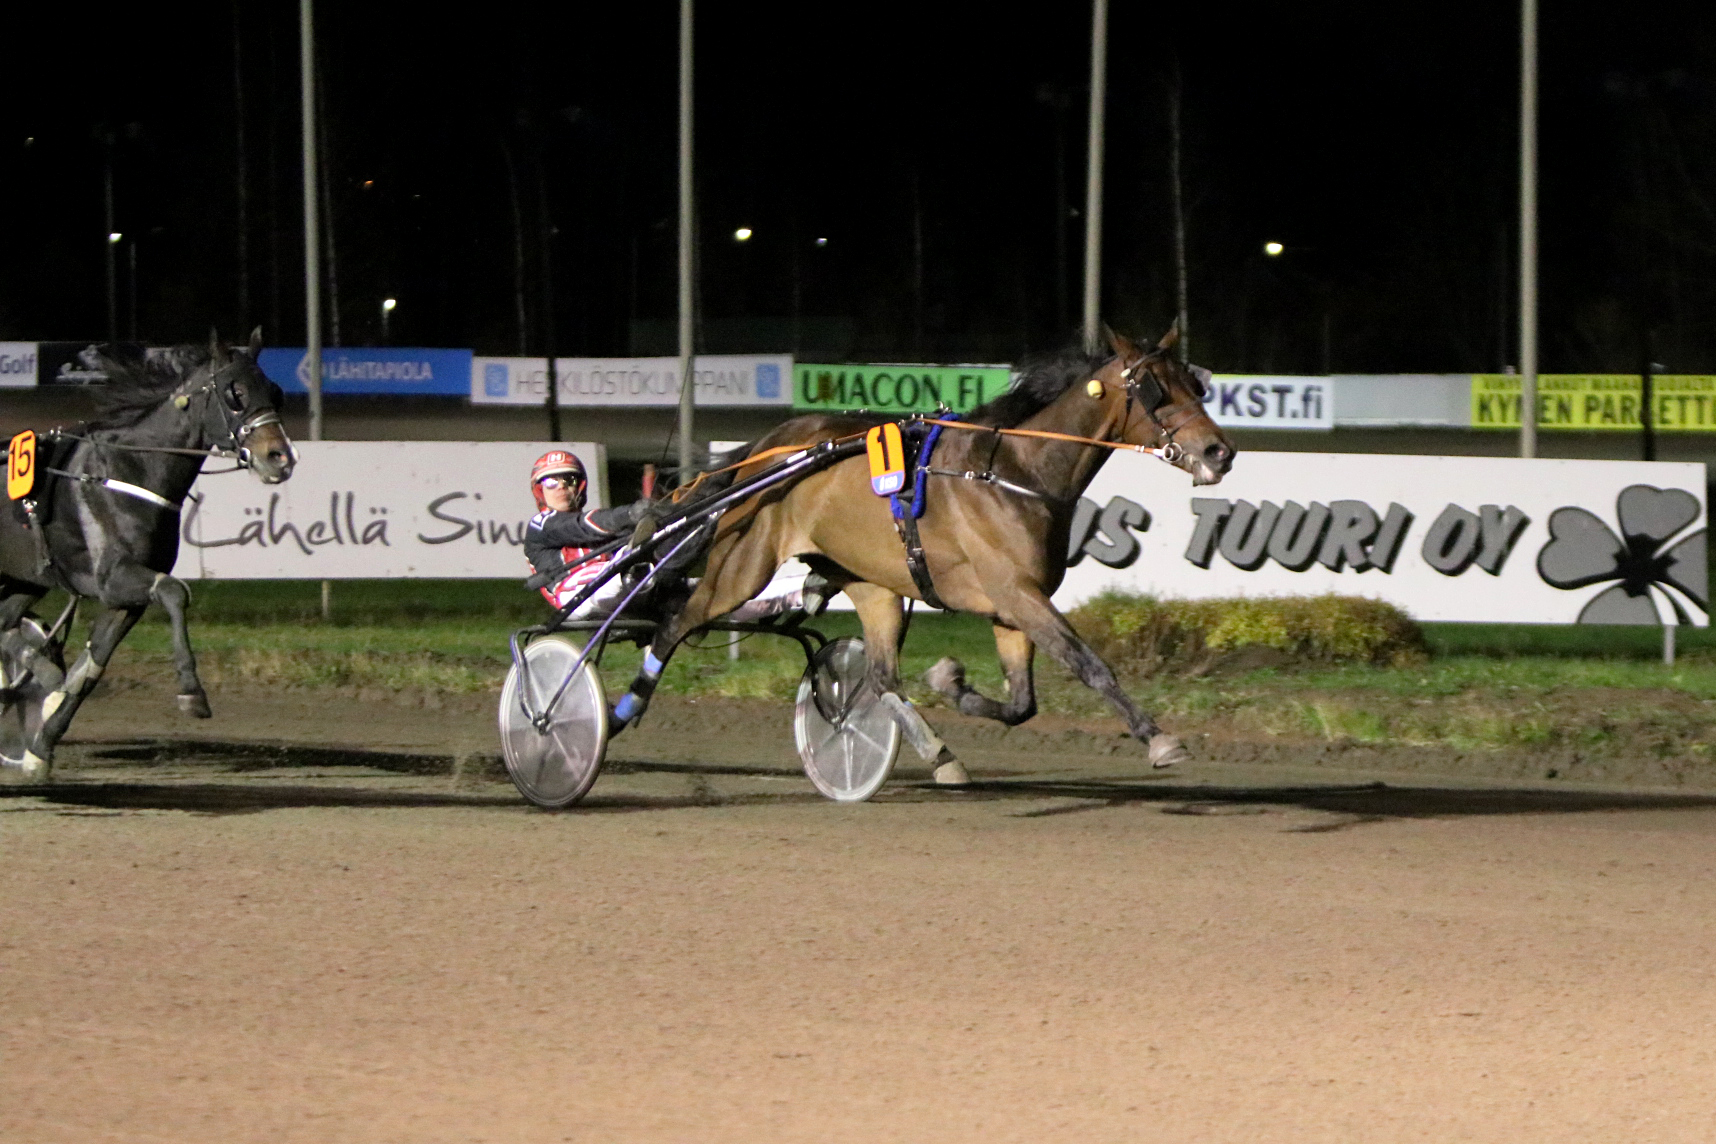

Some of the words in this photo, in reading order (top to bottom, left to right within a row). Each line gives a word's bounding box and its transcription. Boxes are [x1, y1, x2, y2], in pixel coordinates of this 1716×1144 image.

[0, 354, 35, 374] Golf
[1584, 393, 1716, 425] PARETT
[10, 435, 32, 480] 15
[876, 425, 891, 471] 1
[183, 491, 390, 556] Lähellä
[1185, 497, 1416, 575] TUURI
[1421, 502, 1532, 577] OY
